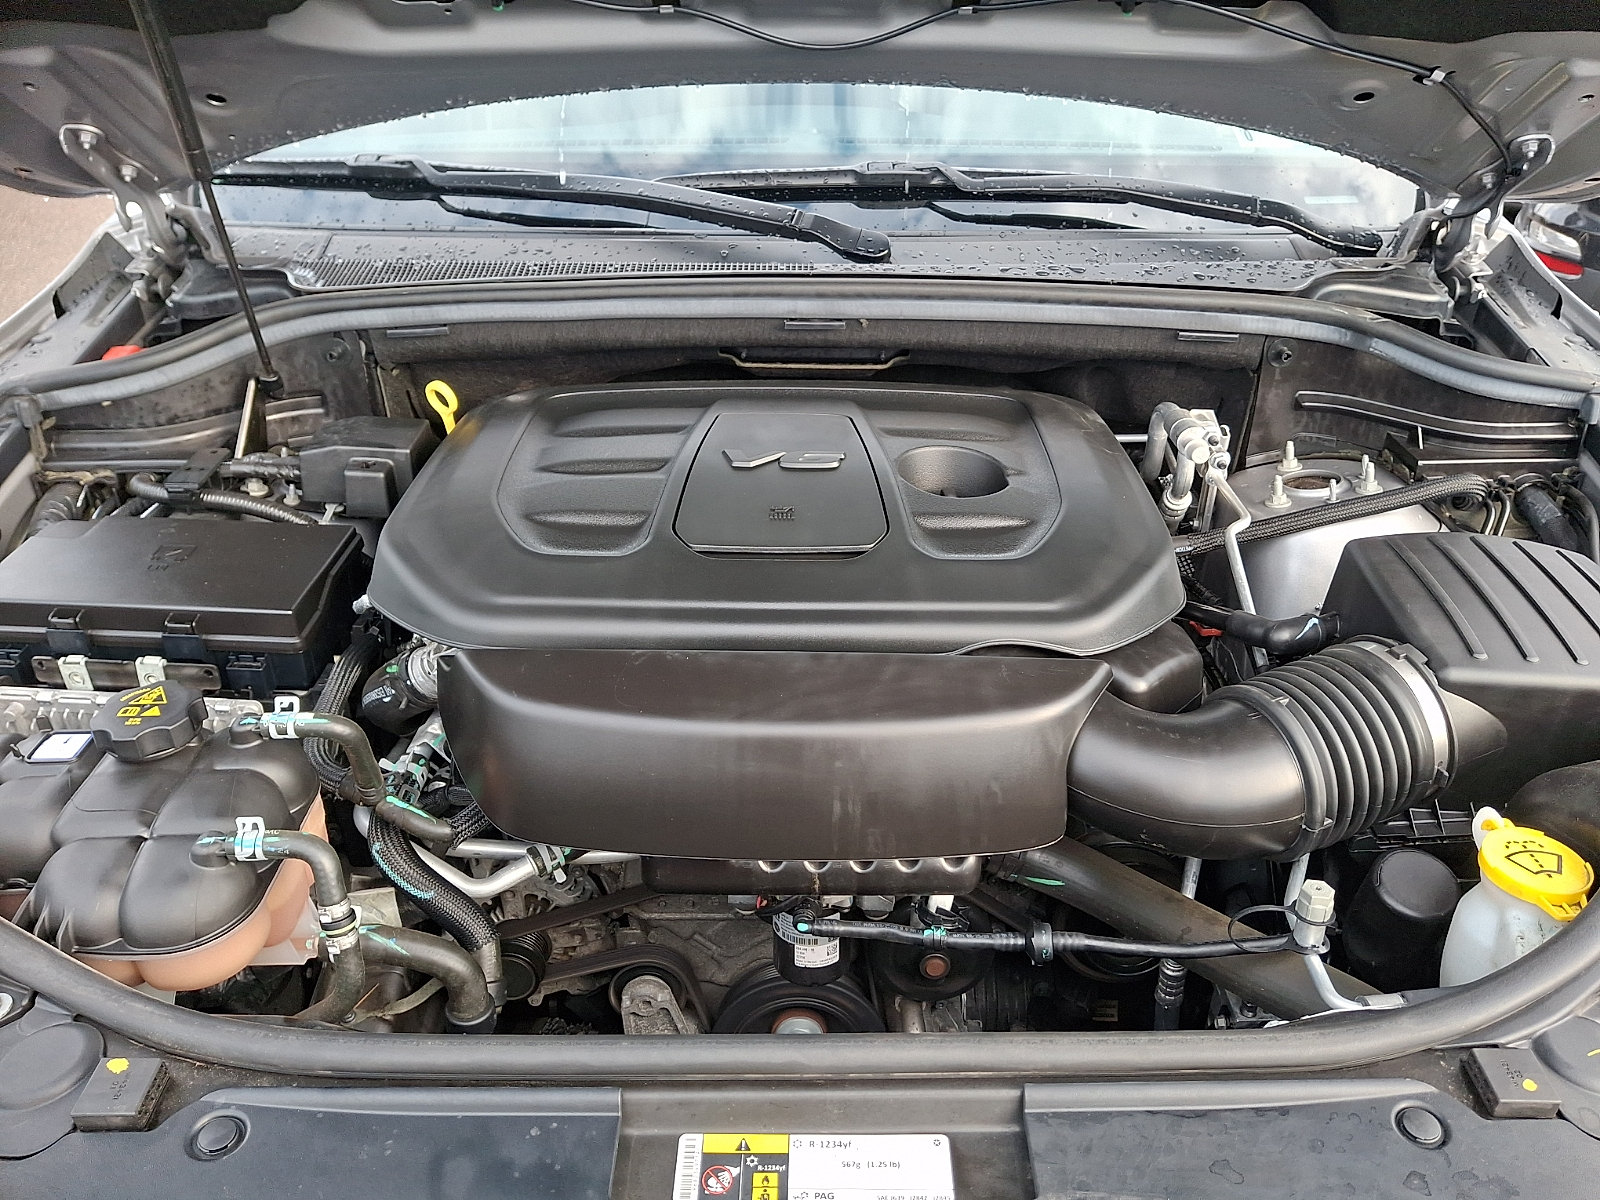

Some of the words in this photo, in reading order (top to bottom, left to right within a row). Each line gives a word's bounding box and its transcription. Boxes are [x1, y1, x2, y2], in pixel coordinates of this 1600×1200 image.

[722, 449, 847, 469] V6
[809, 1140, 852, 1149] R-1234yf
[757, 1164, 786, 1172] R-1234yf
[841, 1160, 861, 1169] 567g
[867, 1160, 888, 1169] (1.25
[889, 1160, 901, 1169] lb)
[814, 1192, 835, 1200] PAG
